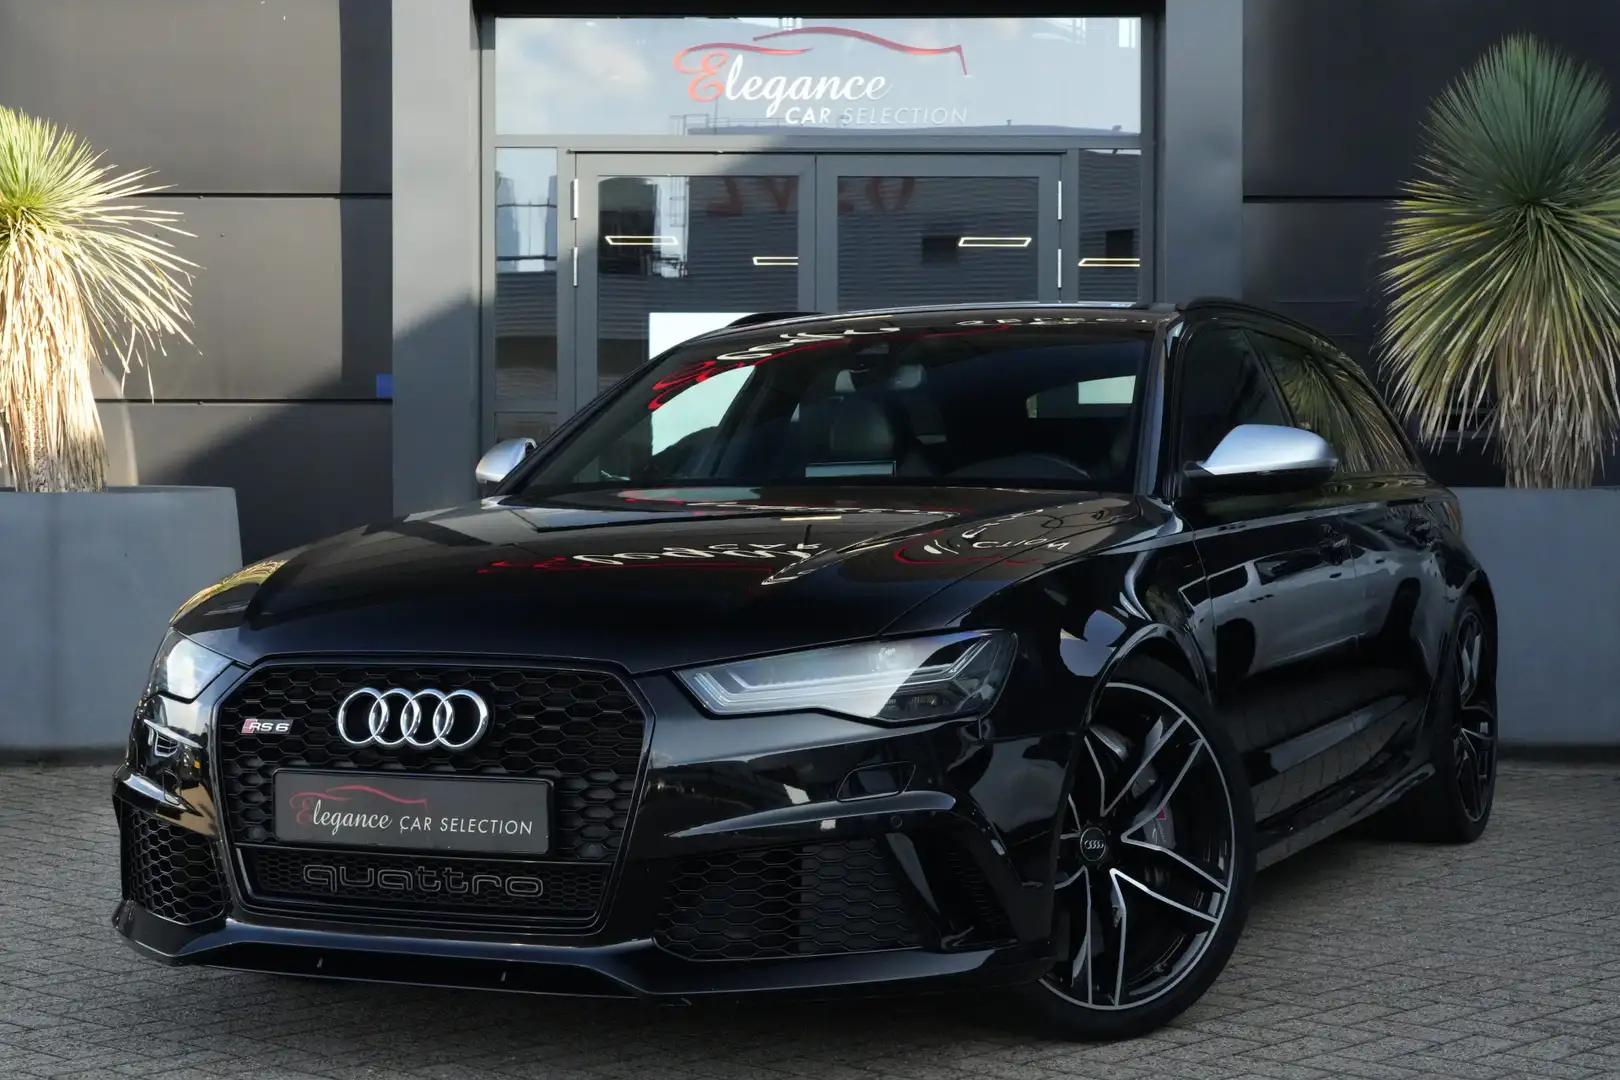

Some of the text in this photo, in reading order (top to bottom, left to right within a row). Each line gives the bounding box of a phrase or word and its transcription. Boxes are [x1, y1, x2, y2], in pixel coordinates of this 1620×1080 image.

[672, 47, 894, 118] Elegance
[785, 106, 969, 125] CAR SELECTION
[289, 794, 534, 836] Elegance CAR SELECTION
[302, 864, 544, 898] quattro
